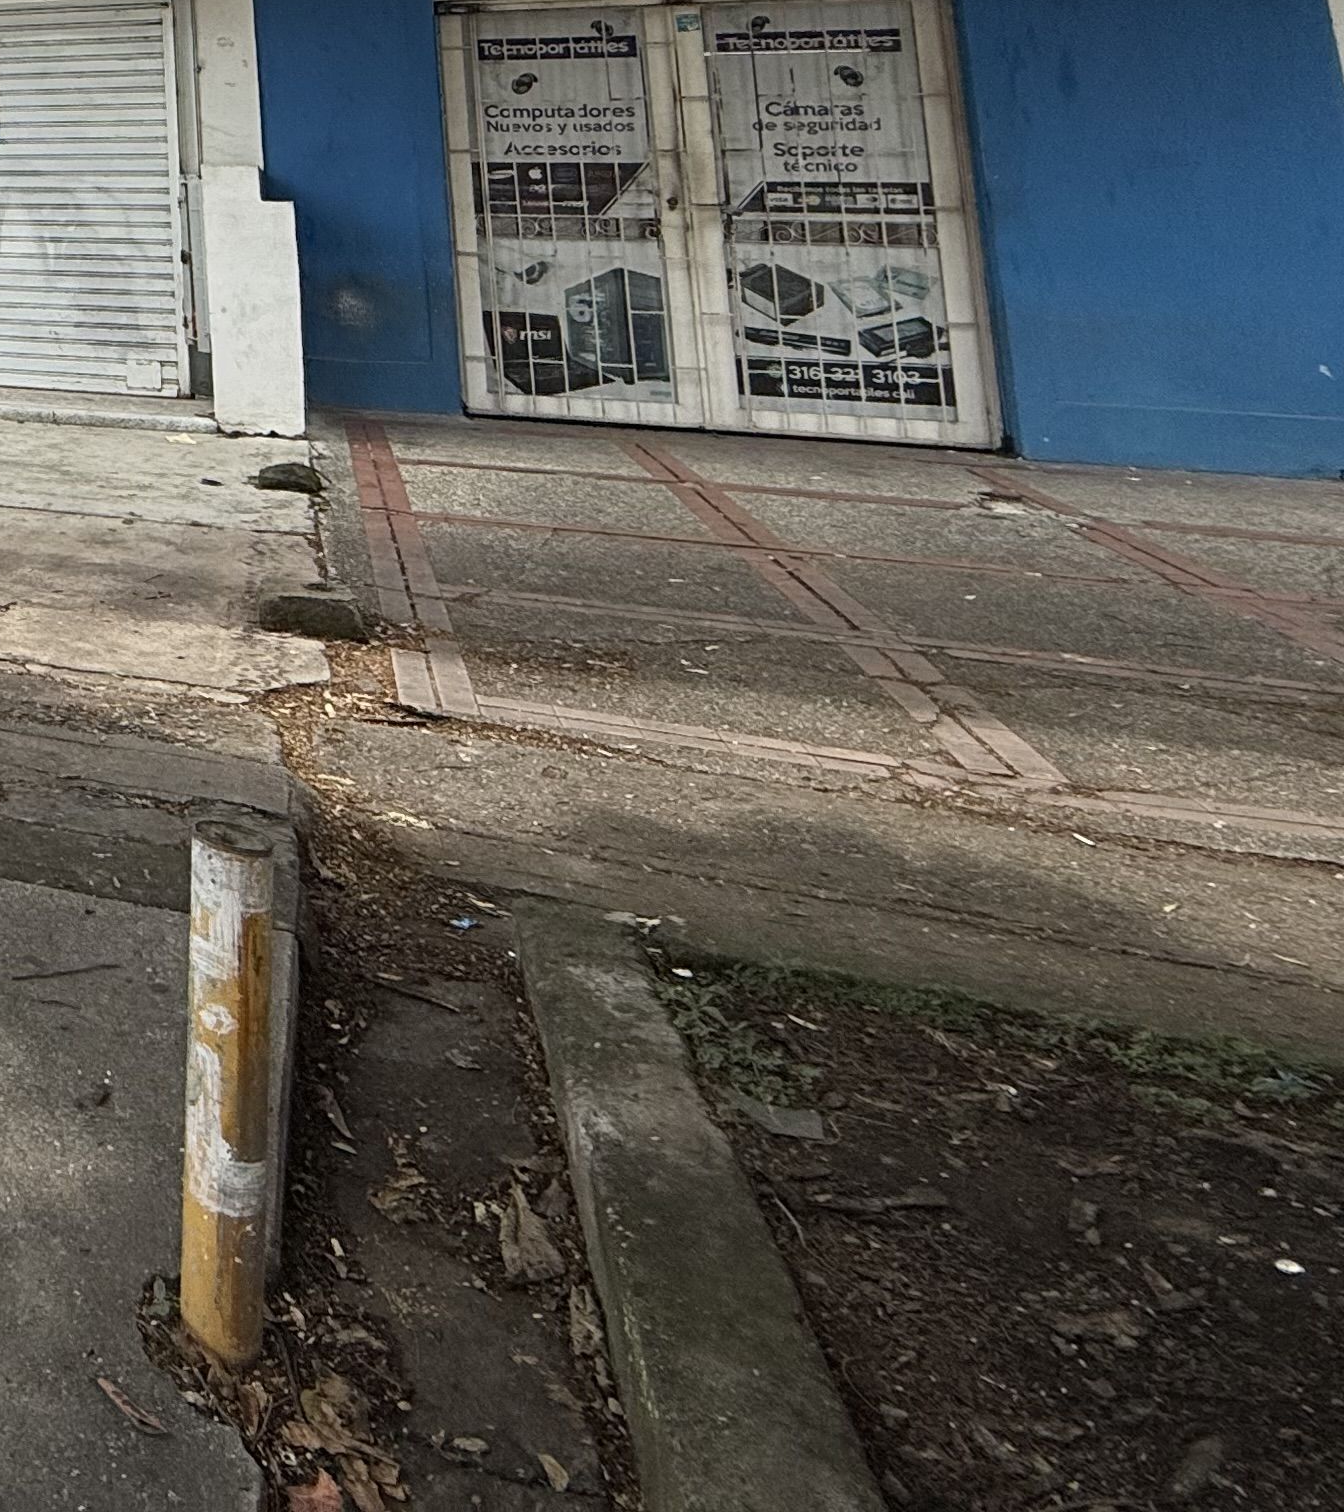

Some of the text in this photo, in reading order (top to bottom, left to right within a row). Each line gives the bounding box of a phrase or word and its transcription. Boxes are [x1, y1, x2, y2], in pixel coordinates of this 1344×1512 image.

[480, 40, 630, 56] Tecnoportáties
[725, 35, 894, 51] Tecnoportáties
[484, 104, 636, 122] Computadores
[486, 120, 636, 136] Nuevos y usados
[752, 117, 882, 134] de seguridad
[784, 158, 858, 174] técnico
[788, 365, 822, 380] 316
[872, 370, 921, 385] 3103
[792, 384, 890, 399] tecnportailes
